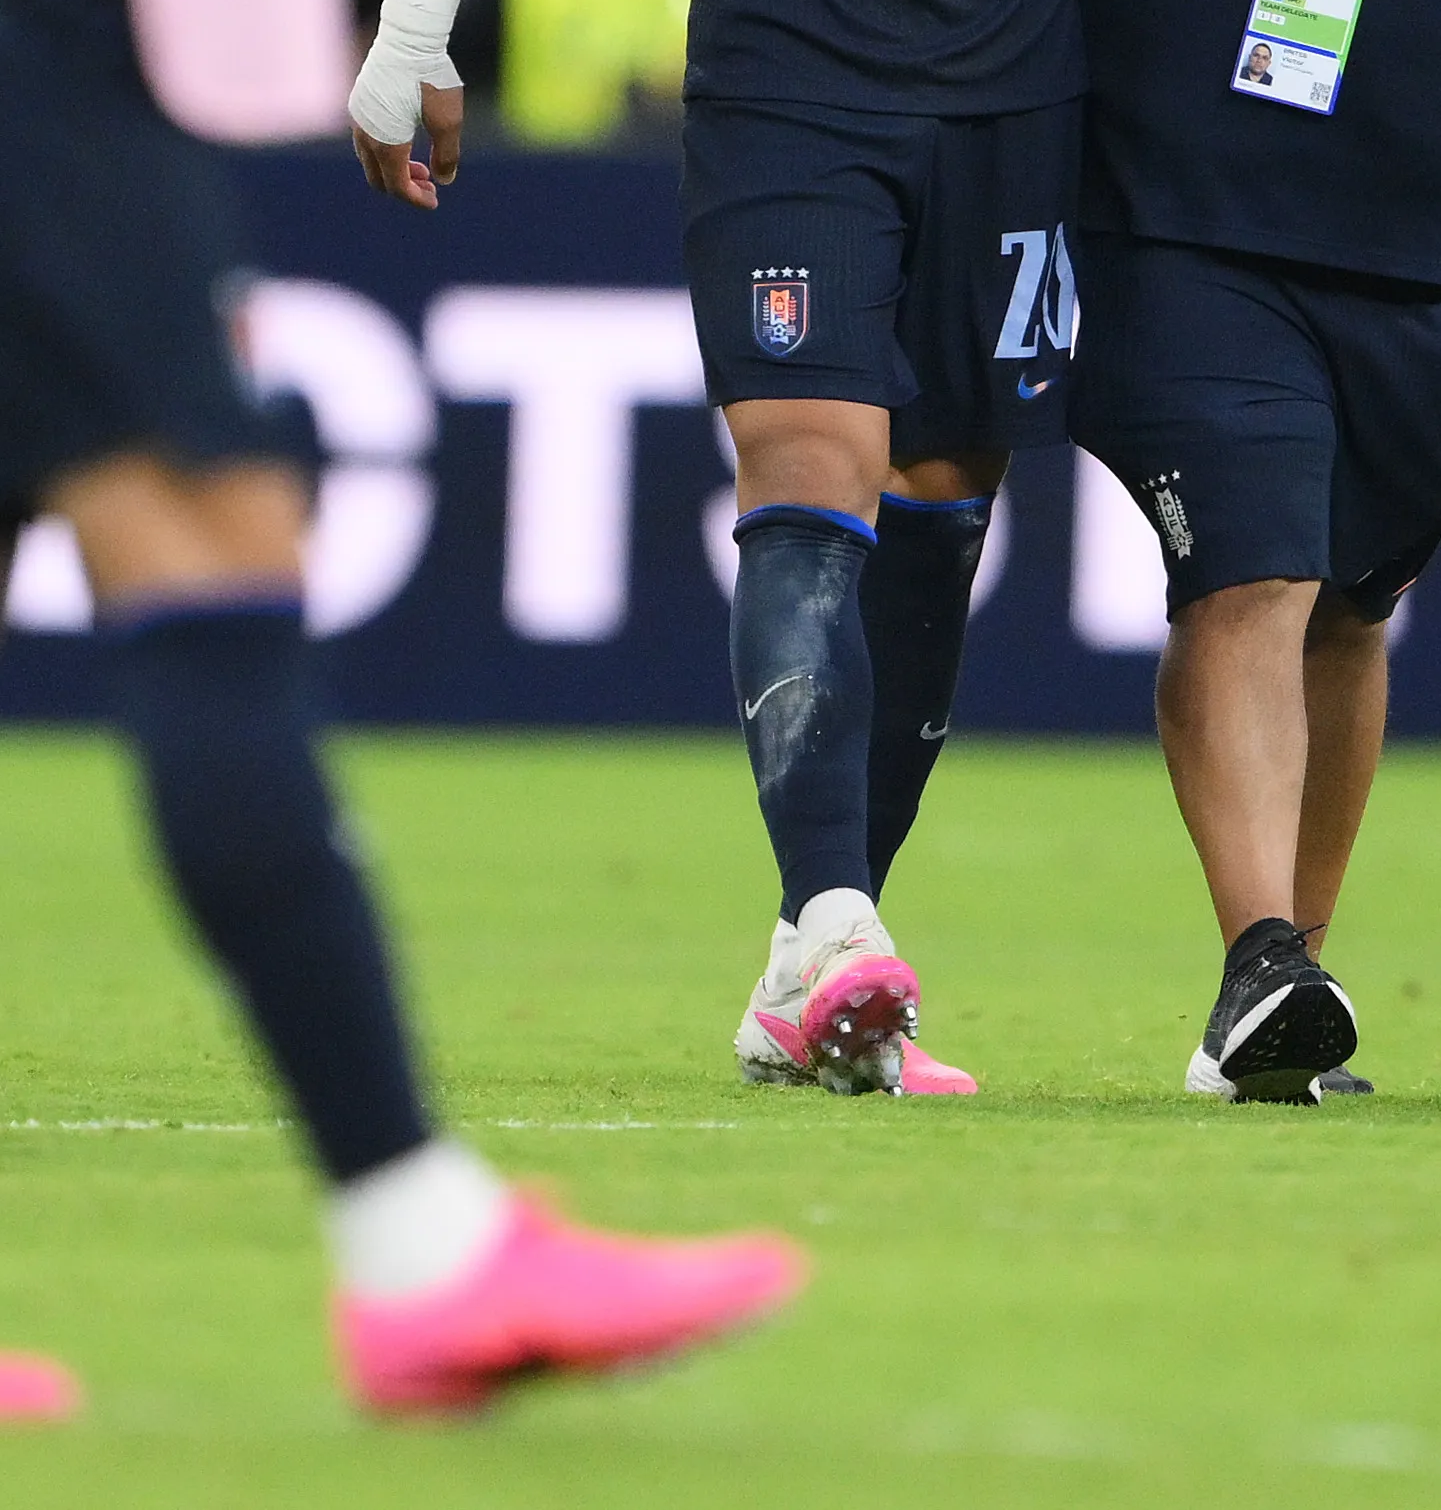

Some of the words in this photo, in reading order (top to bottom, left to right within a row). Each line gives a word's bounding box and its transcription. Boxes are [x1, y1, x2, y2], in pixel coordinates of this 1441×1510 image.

[1260, 0, 1280, 10] TEAM
[1280, 6, 1318, 20] DELEGATE
[993, 221, 1076, 359] 20
